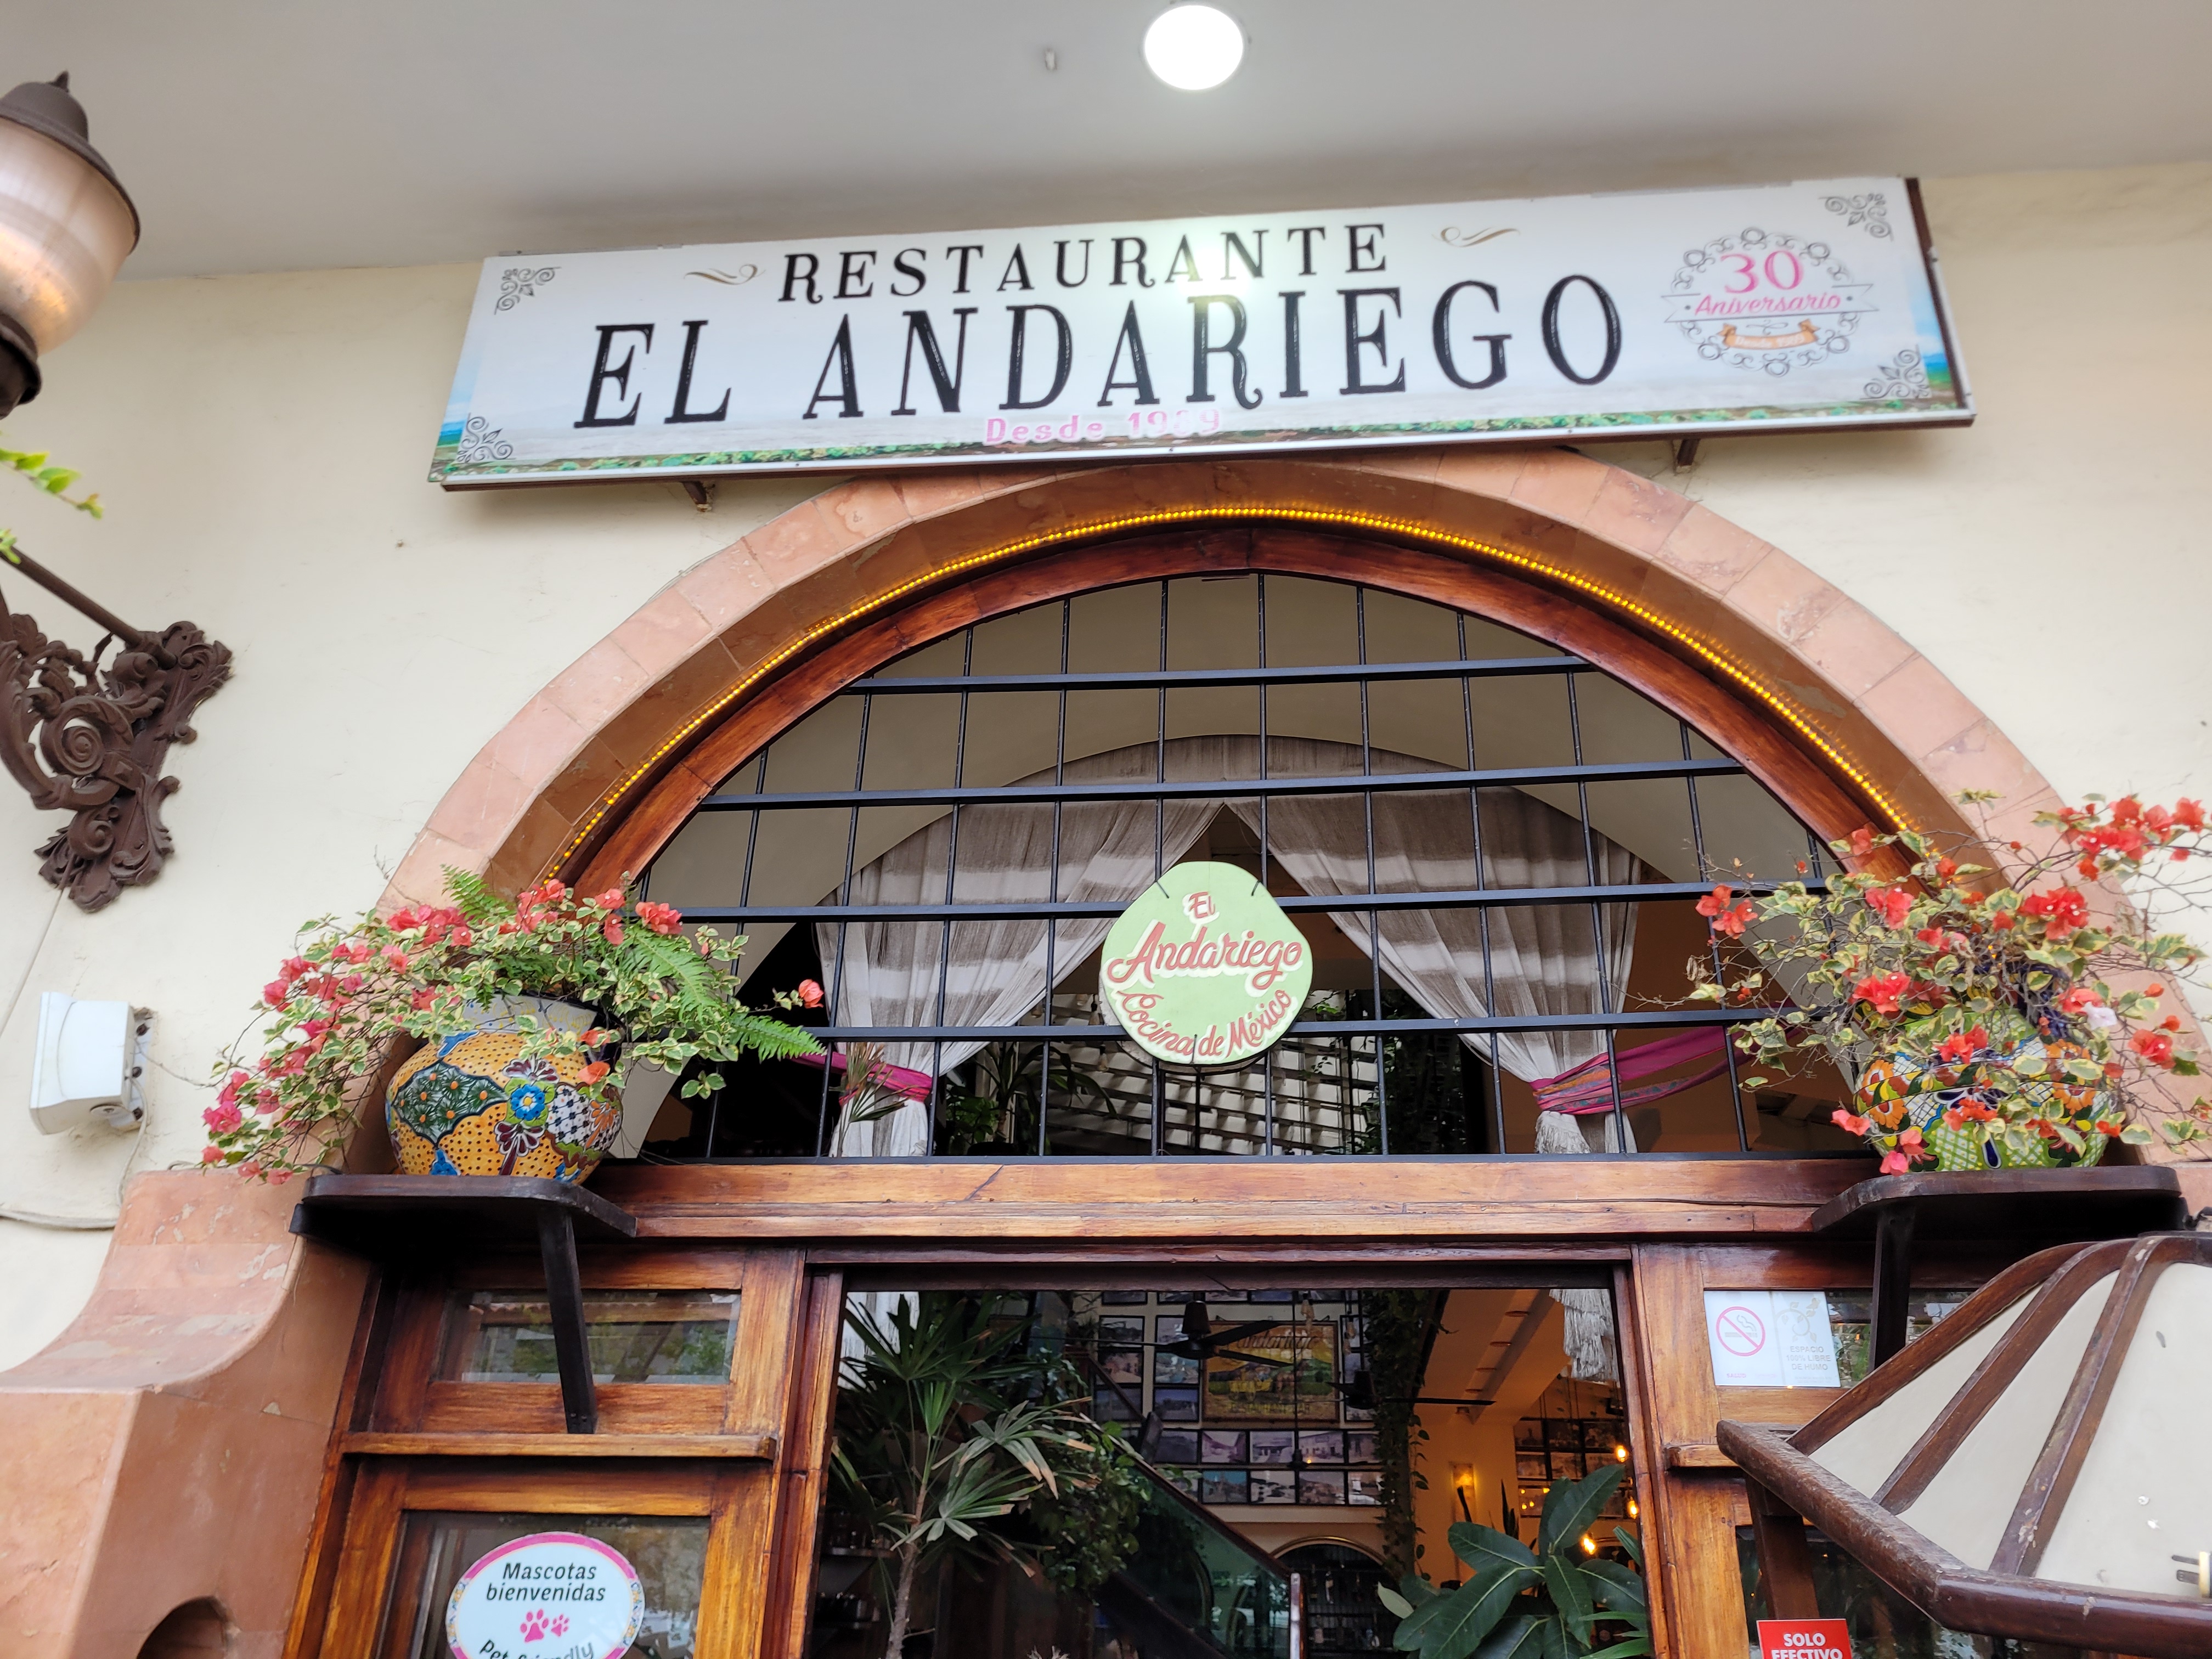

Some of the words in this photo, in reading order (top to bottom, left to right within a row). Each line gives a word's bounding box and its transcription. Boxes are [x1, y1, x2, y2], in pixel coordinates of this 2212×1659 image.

[778, 224, 1387, 304] RESTAURANTE
[1720, 249, 1804, 294] 30
[1694, 292, 1841, 315] Aniversario
[574, 319, 732, 429] EL
[802, 274, 1622, 419] ANDARIEGO
[986, 415, 1104, 443] Desde
[1127, 409, 1220, 436] 1989
[1189, 891, 1216, 918] El
[1107, 922, 1302, 990] Andariego
[1117, 991, 1194, 1056] Cocina
[1198, 1025, 1224, 1057] de
[1226, 990, 1291, 1058] México
[503, 1562, 596, 1580] Mascotas
[486, 1583, 606, 1601] bienvenidas
[1771, 1649, 1843, 1659] EFECTIVO
[1784, 1633, 1826, 1646] SOLO
